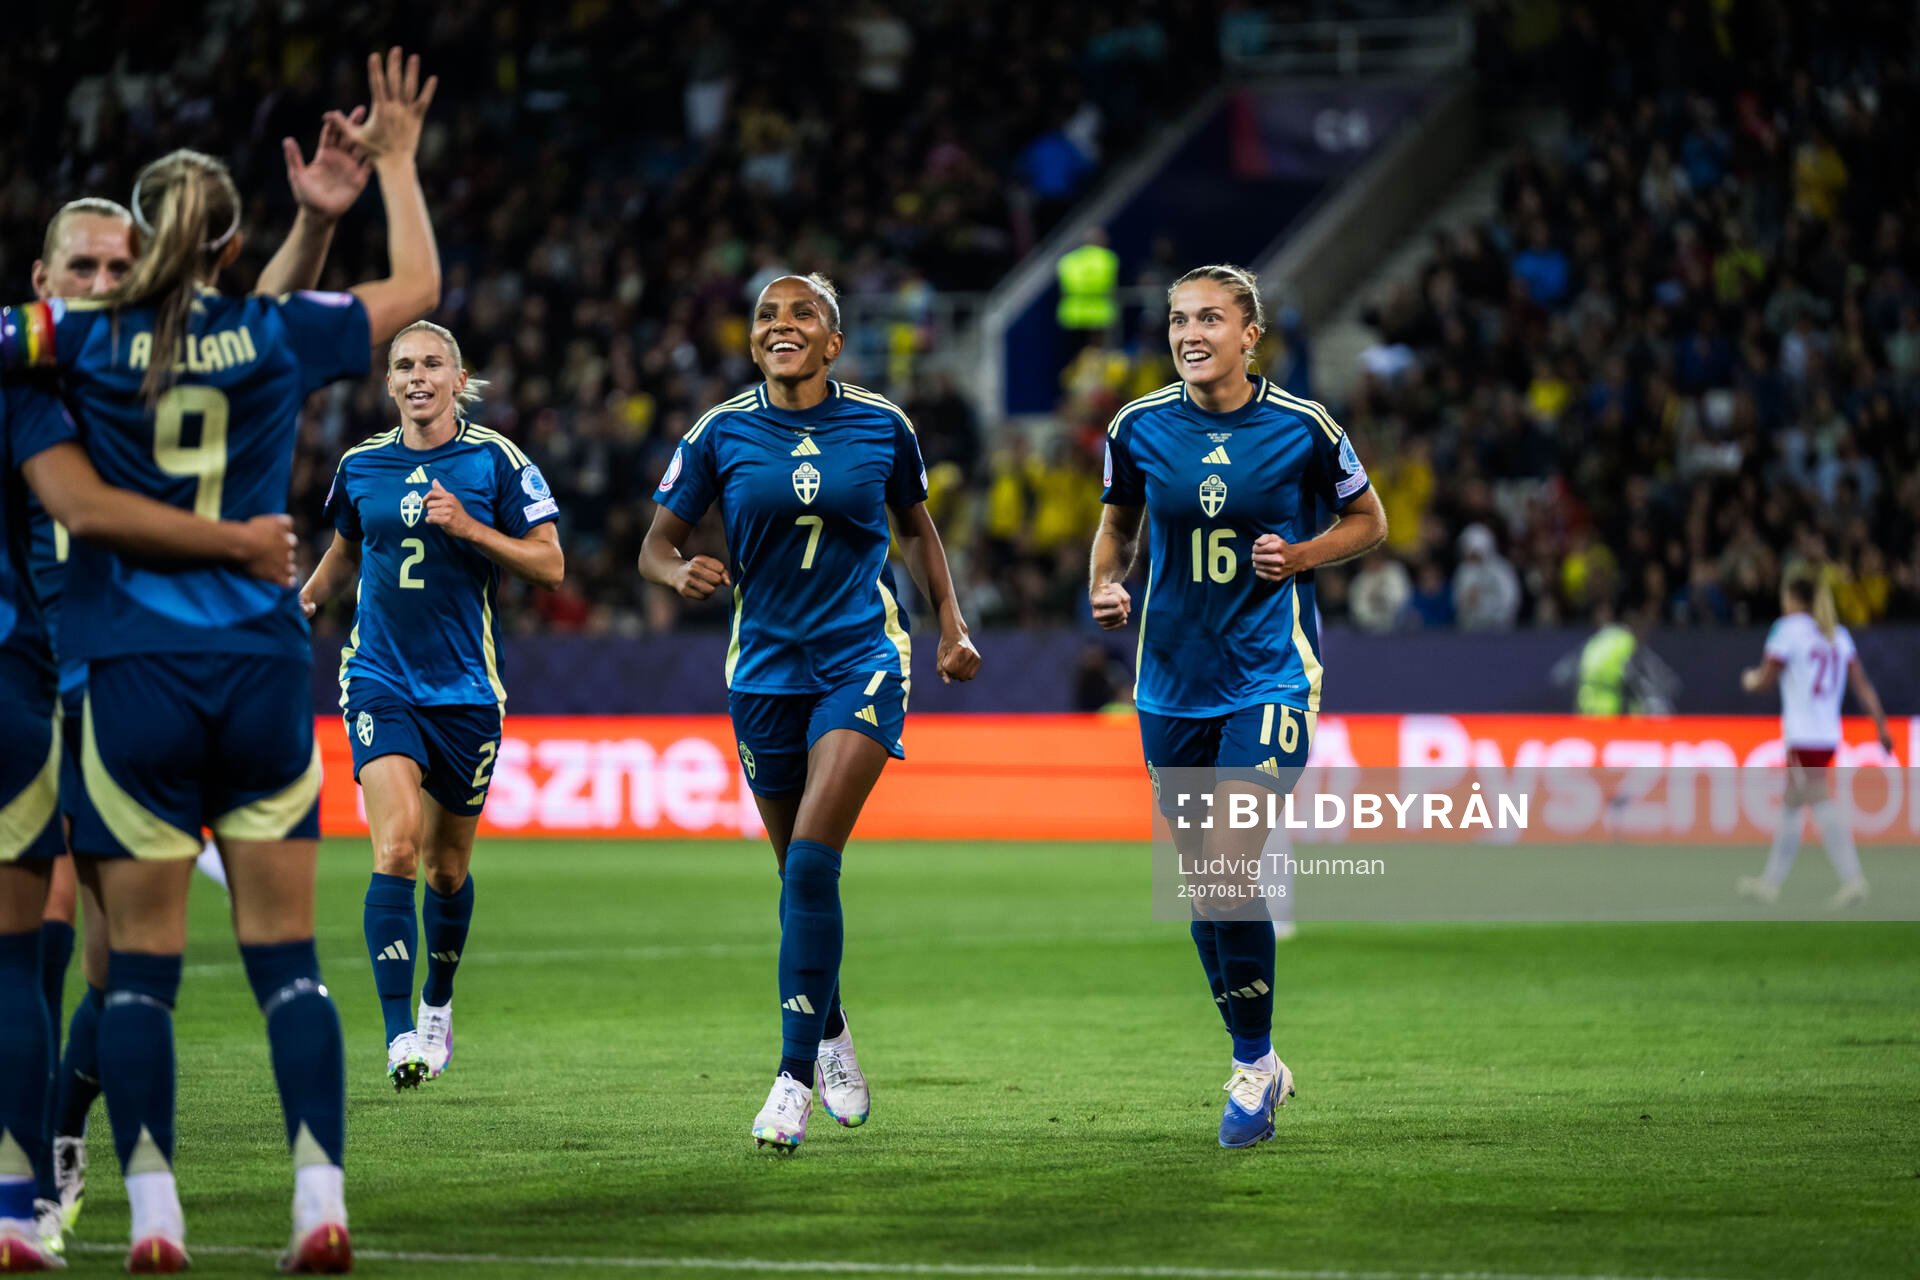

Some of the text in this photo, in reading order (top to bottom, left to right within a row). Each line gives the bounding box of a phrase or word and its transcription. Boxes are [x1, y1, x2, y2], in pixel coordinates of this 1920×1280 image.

[129, 325, 257, 373] ALLANI
[153, 384, 230, 522] 9
[399, 537, 425, 589] 2
[794, 515, 824, 570] 7
[1191, 528, 1237, 584] 16
[1808, 646, 1840, 699] 21
[1259, 703, 1303, 753] 16
[471, 740, 496, 788] 2
